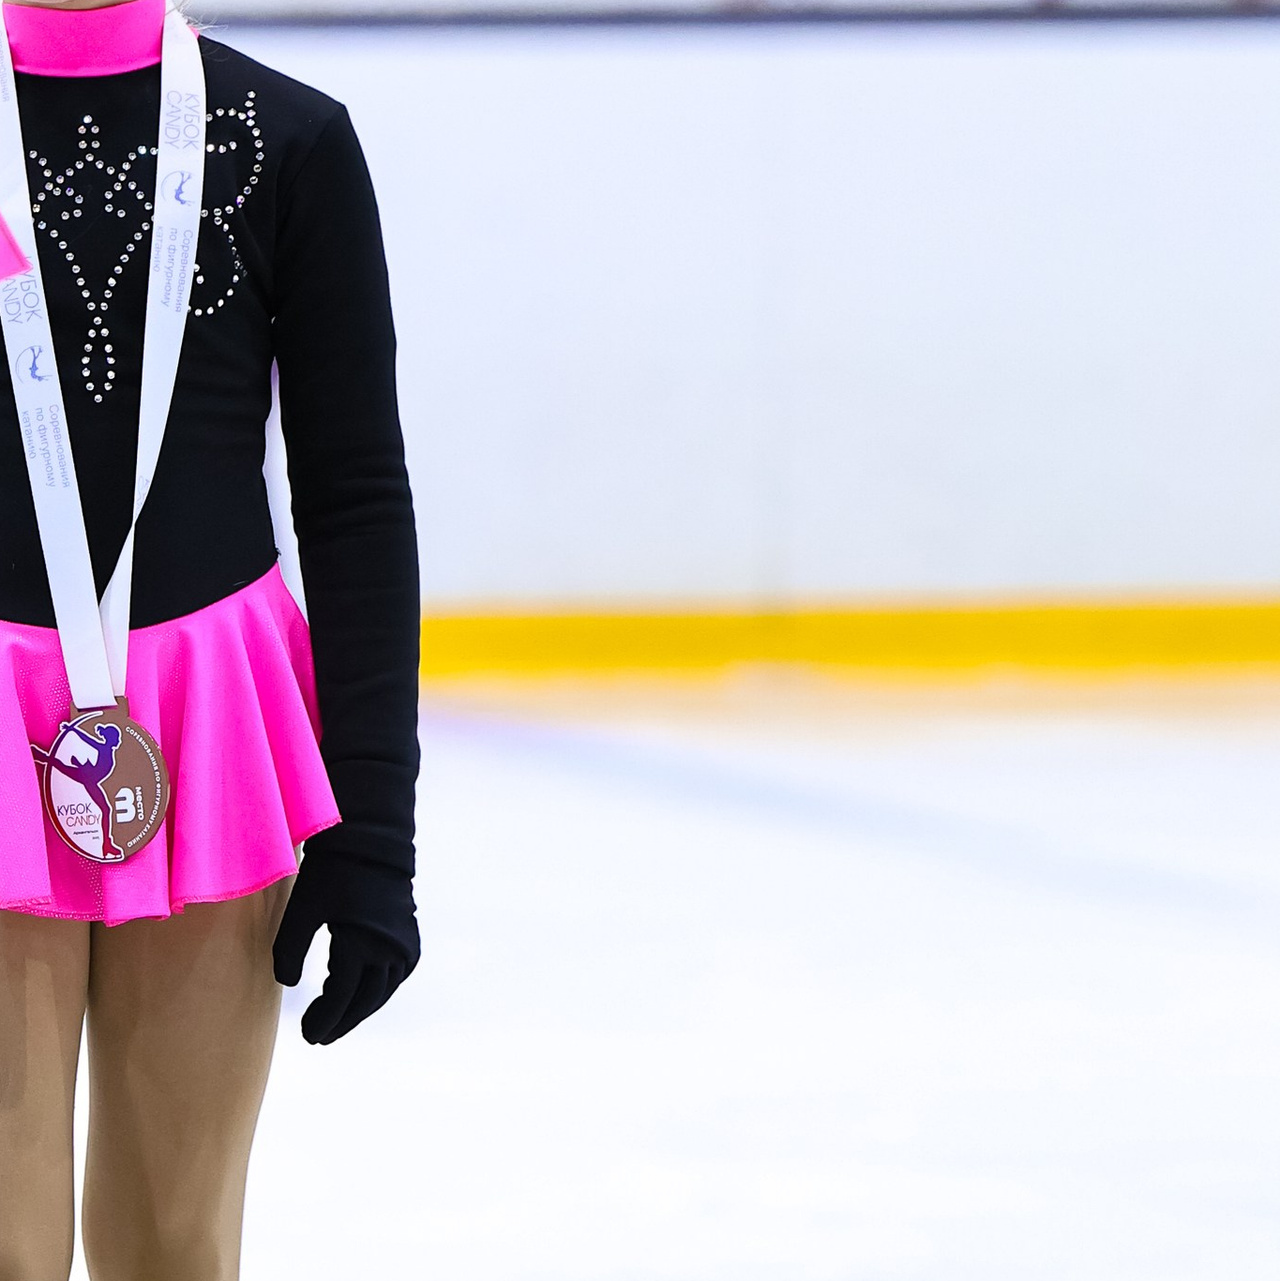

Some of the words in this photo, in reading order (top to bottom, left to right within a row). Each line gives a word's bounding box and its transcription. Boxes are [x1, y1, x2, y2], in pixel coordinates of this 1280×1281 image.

[164, 90, 182, 151] CANDY
[182, 92, 200, 151] КУБОК
[153, 225, 164, 273] катанию
[169, 227, 178, 243] по
[161, 244, 177, 308] фигурному
[175, 229, 194, 313] Соревнования
[2, 277, 23, 324] ANDY
[22, 410, 37, 460] катанию
[35, 407, 44, 422] по
[36, 423, 56, 488] фигурному
[48, 404, 70, 489] Соревнования
[125, 726, 159, 771] СОРЕВНОВАНИЯ
[154, 771, 161, 782] ПО
[56, 802, 92, 816] КУБОК
[66, 813, 101, 827] CANDY
[114, 787, 136, 823] 3
[148, 783, 161, 825] ФИГУРНОМУ
[126, 823, 151, 848] КАТАНИЮ
